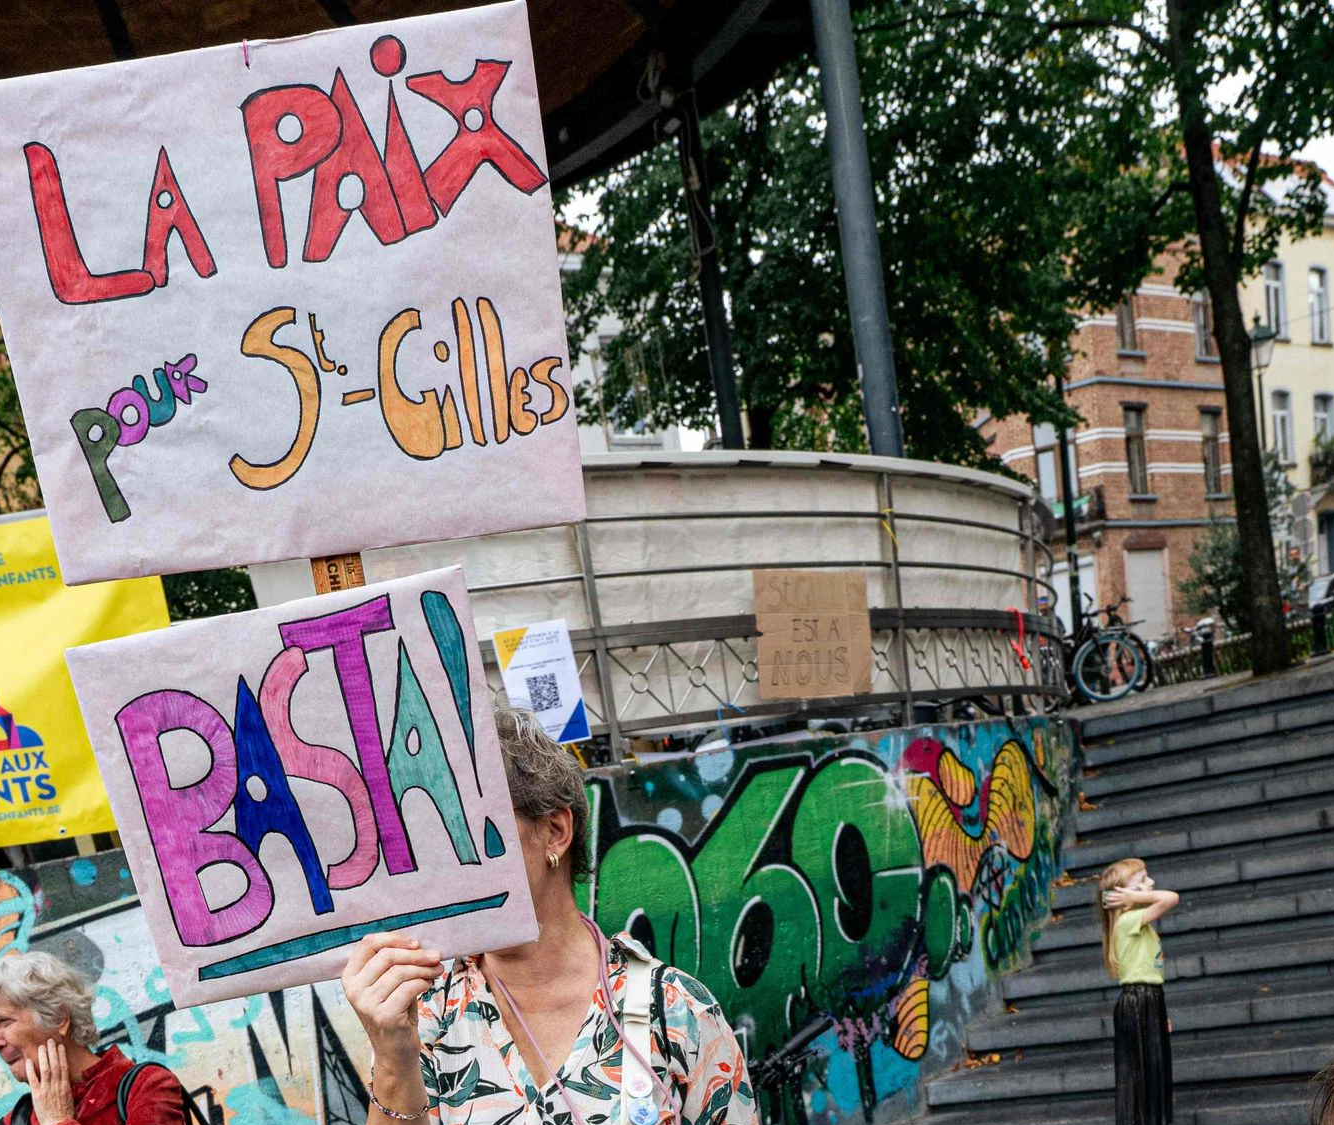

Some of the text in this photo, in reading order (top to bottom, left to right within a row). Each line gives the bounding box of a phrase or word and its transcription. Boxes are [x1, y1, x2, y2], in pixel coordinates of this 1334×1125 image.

[23, 141, 218, 306] LA
[792, 618, 819, 643] EST
[771, 646, 851, 686] NOUS
[1, 750, 50, 774] AUX
[114, 590, 506, 947] BASTA!
